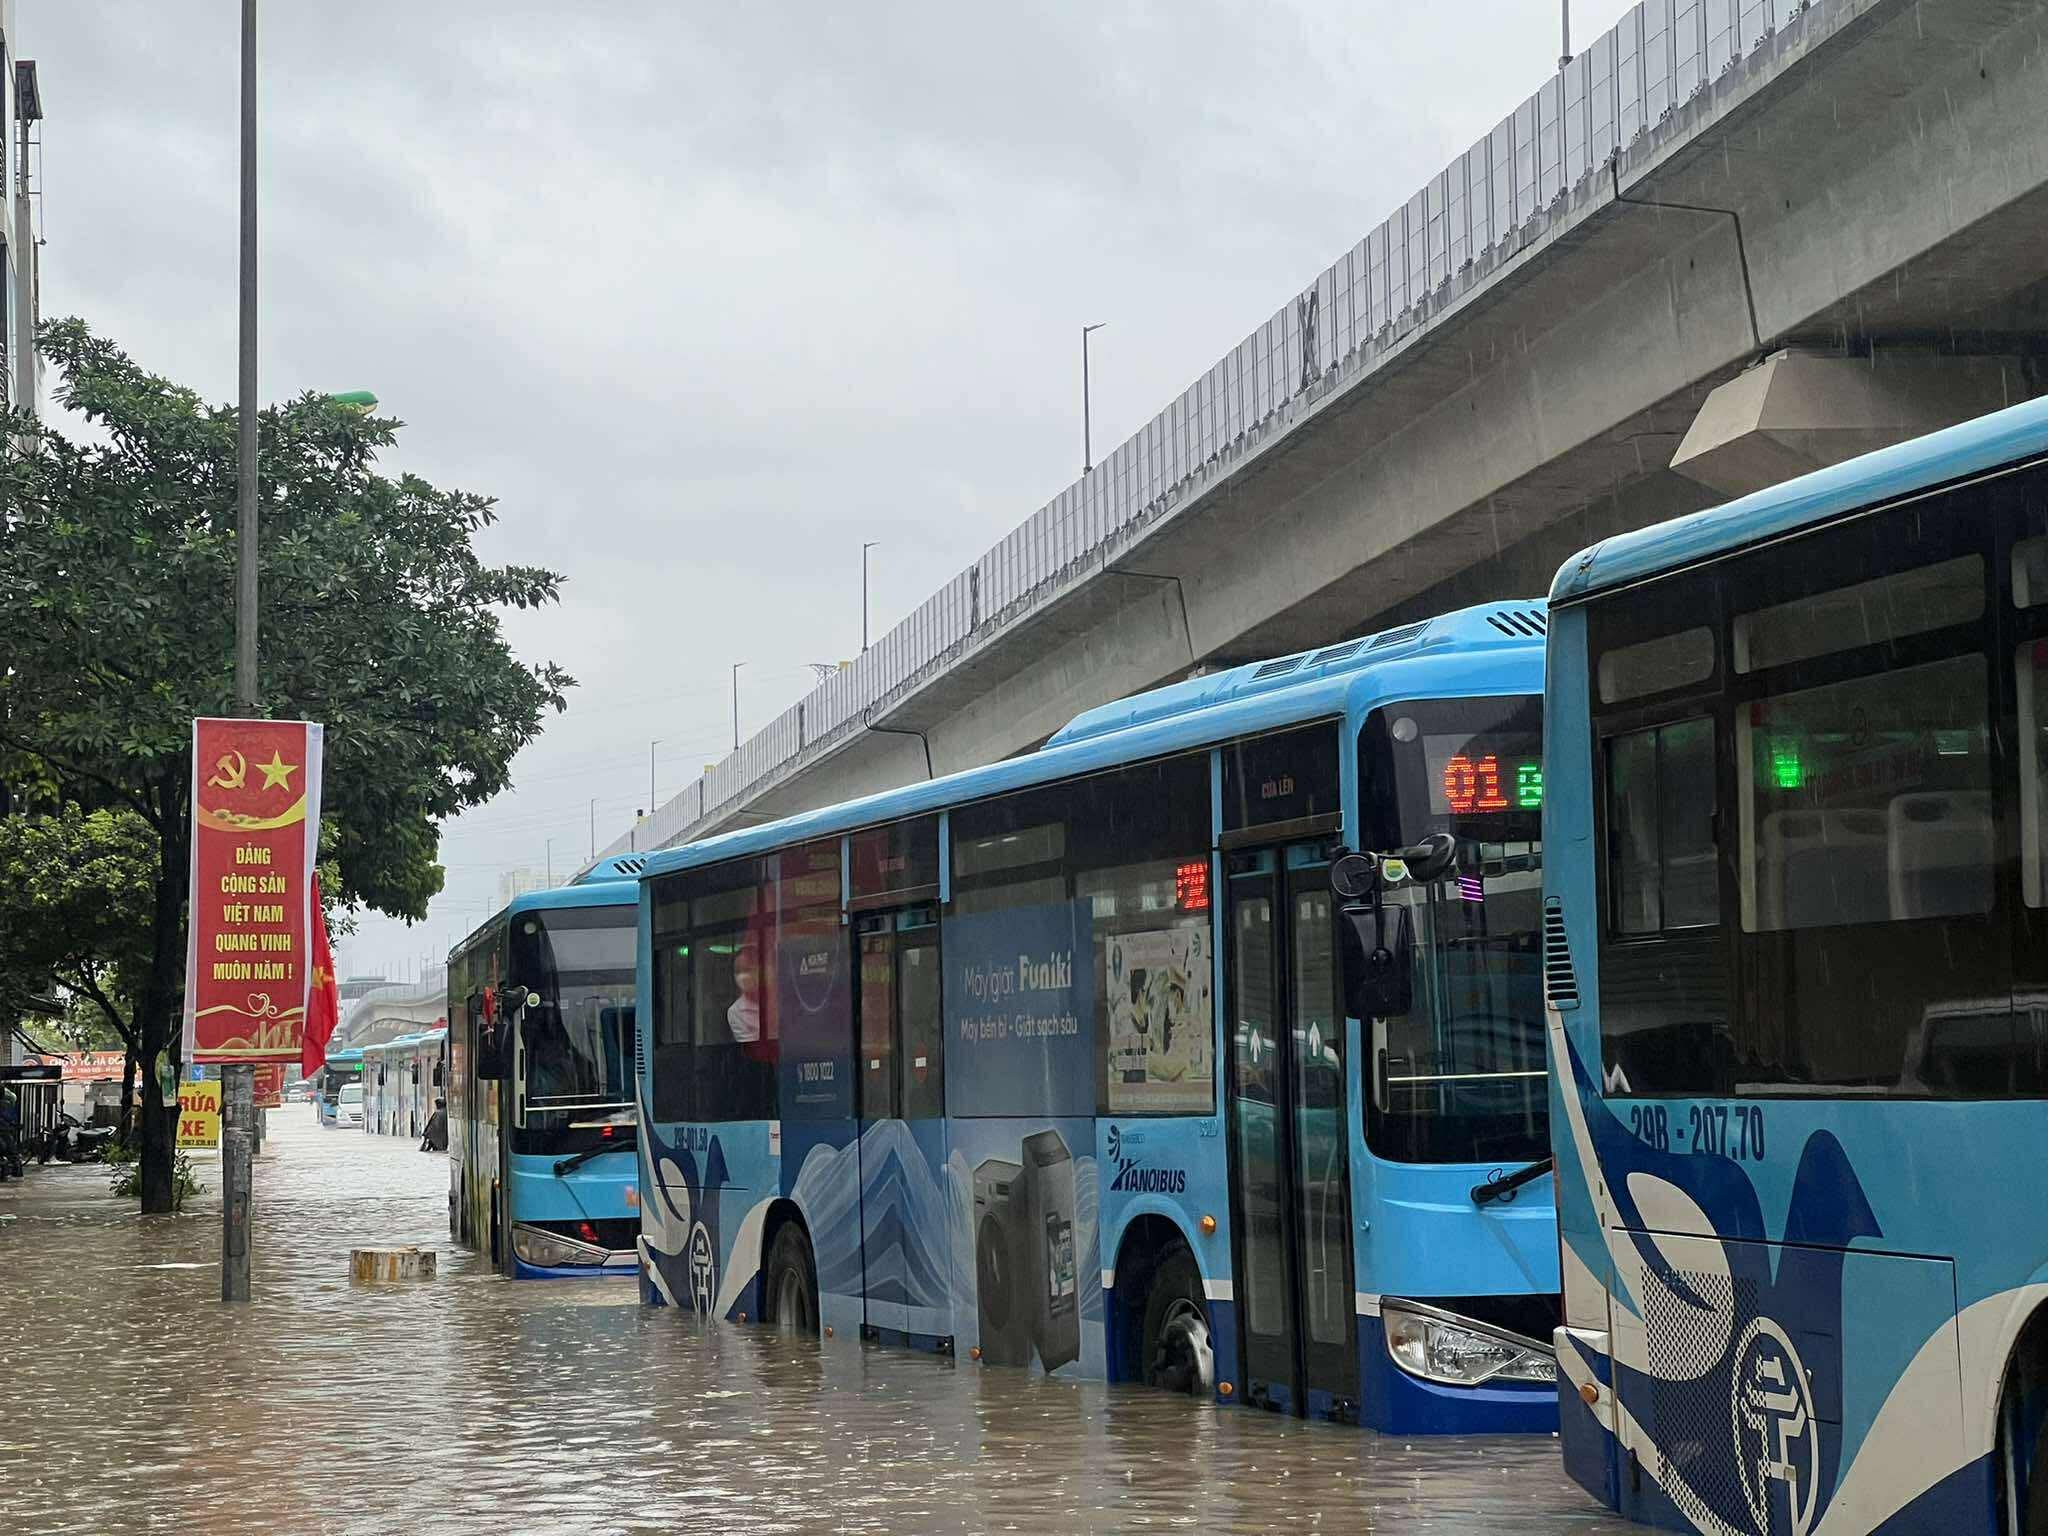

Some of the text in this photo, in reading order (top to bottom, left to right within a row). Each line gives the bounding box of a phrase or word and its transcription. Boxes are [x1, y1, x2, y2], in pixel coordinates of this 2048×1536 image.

[1444, 756, 1508, 808] 01
[236, 842, 271, 865] ĐẢNG
[221, 870, 286, 897] CỘNG SẢN
[223, 902, 283, 926] VIỆT NAM
[215, 934, 291, 953] QUANG VINH
[213, 959, 293, 980] MUÔN NĂM !
[1019, 950, 1072, 992] Funiki
[1061, 1010, 1078, 1035] sâu
[177, 1090, 216, 1112] RỬA
[181, 1120, 205, 1137] XE
[1690, 1105, 1765, 1161] 207.70
[1110, 1158, 1186, 1193] HANOIBUS
